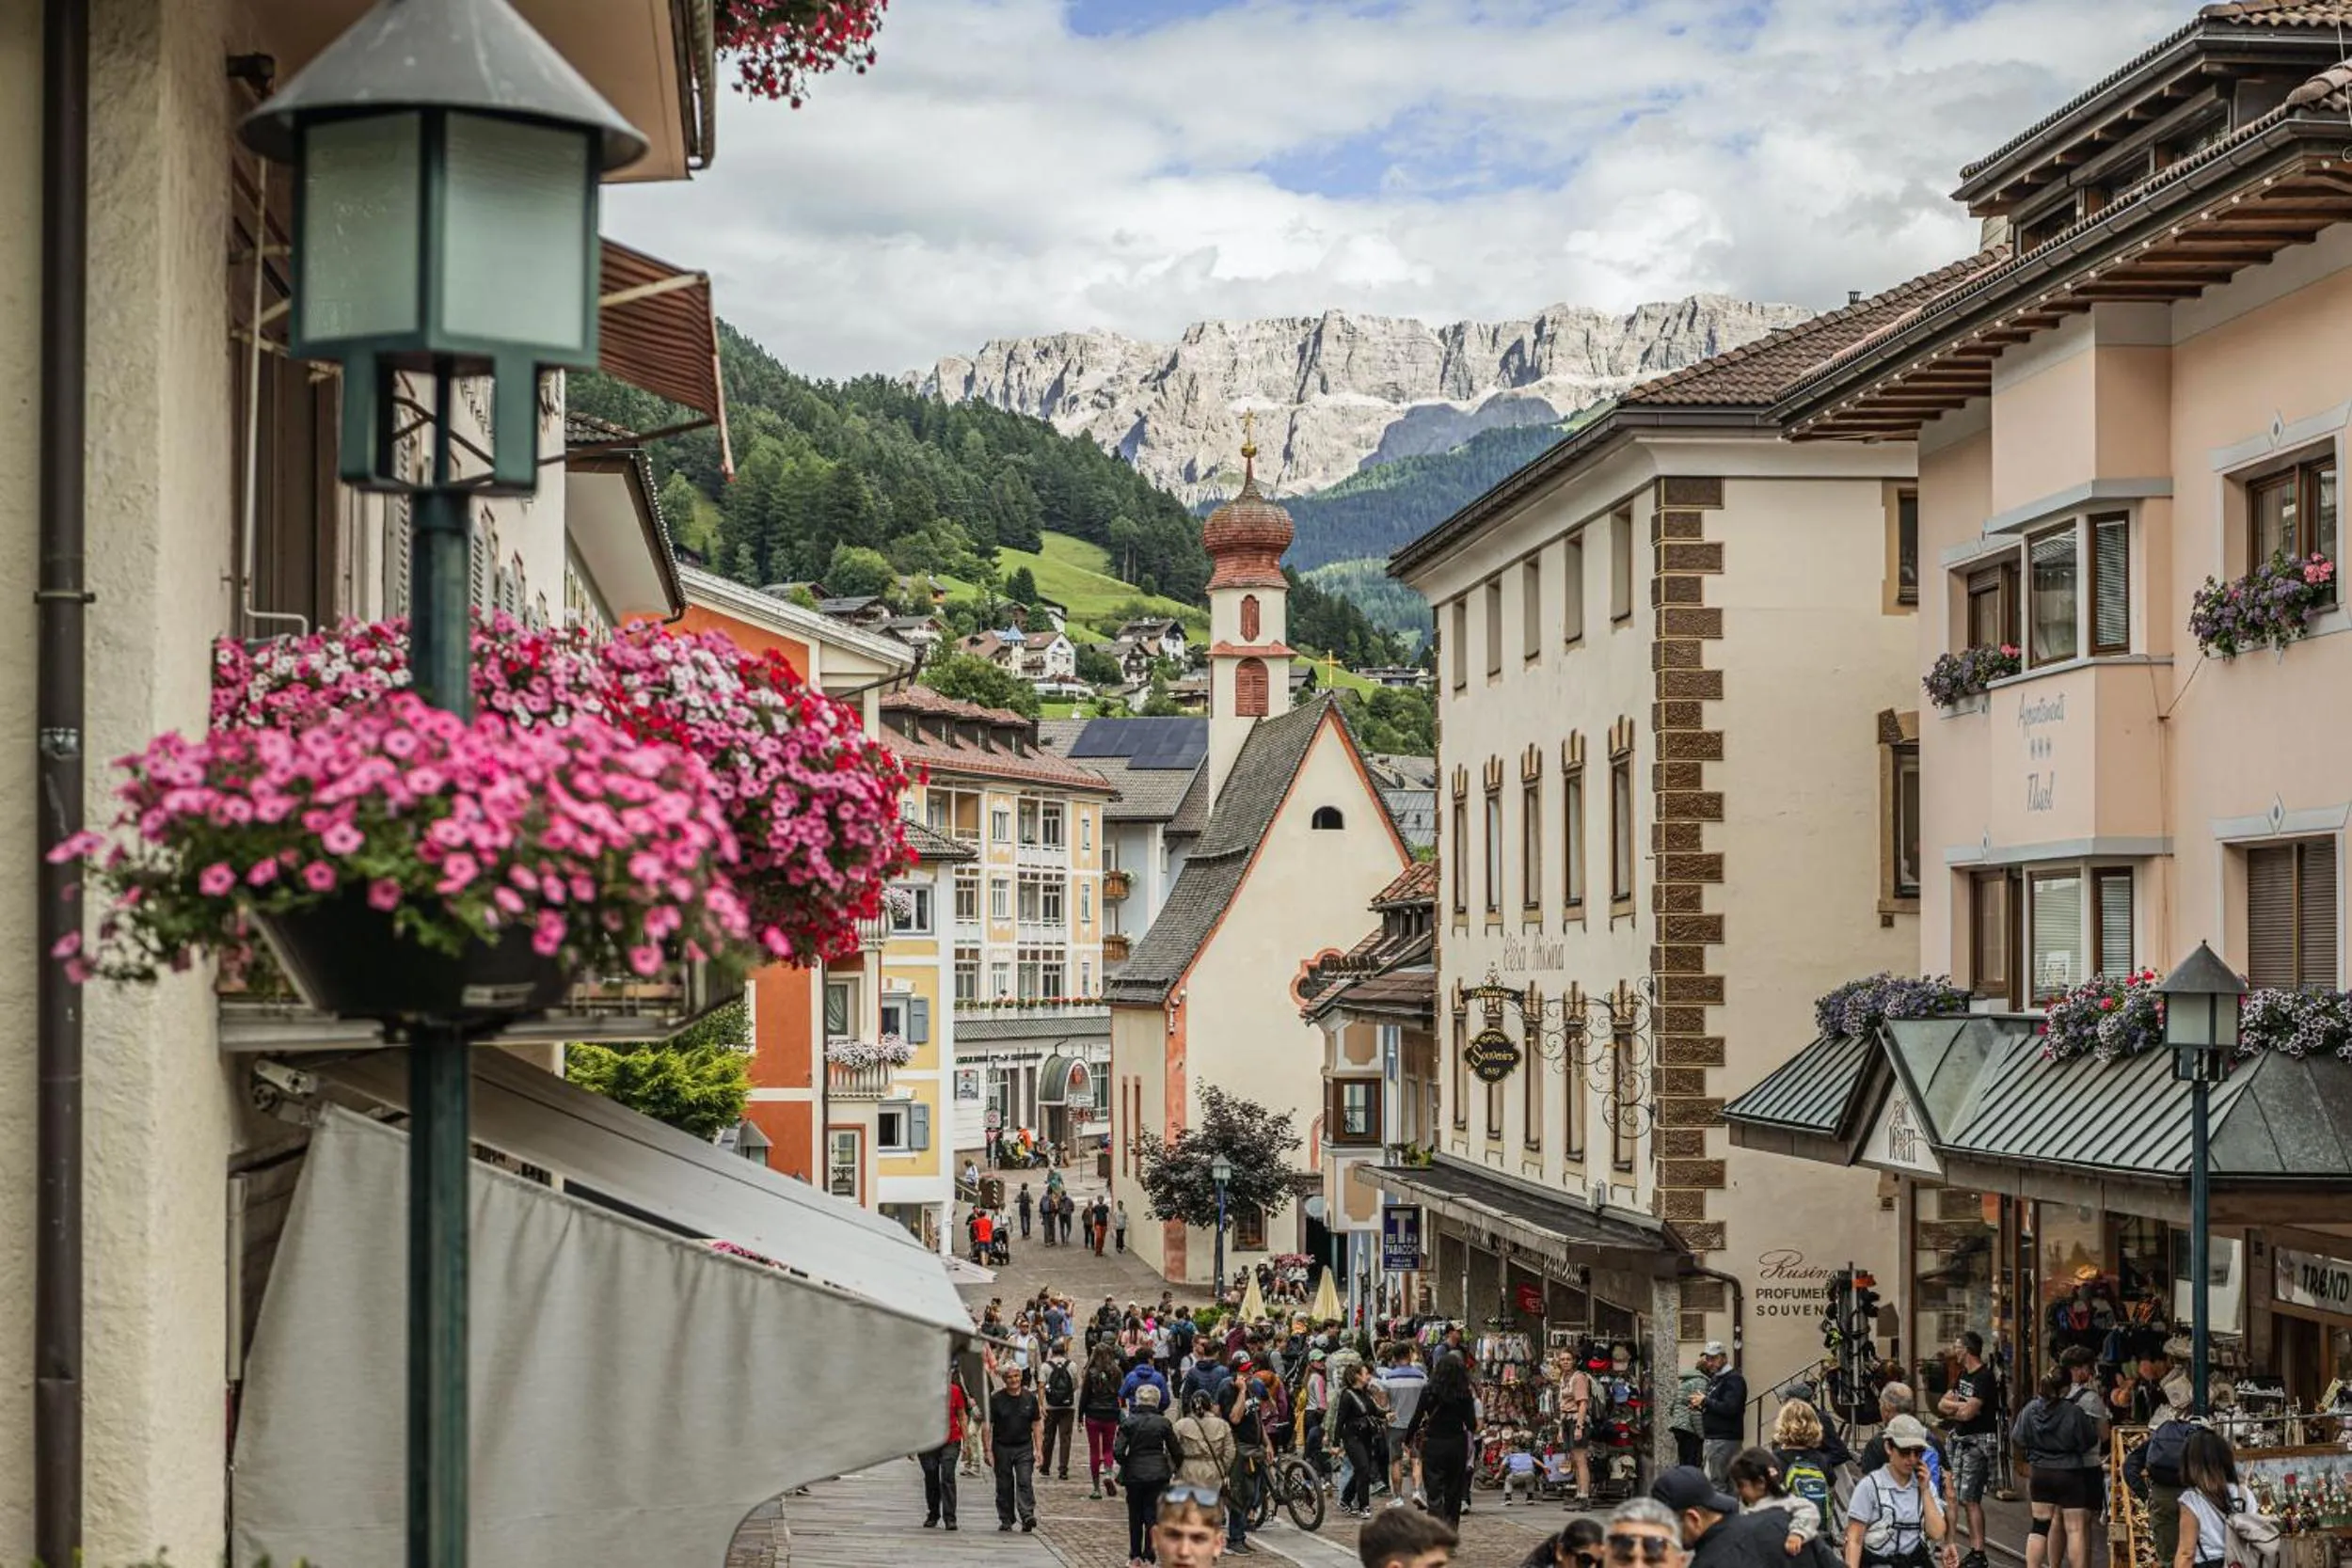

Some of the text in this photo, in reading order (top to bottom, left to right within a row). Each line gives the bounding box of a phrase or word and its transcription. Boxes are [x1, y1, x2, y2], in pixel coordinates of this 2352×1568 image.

[1470, 1044, 1514, 1067] Souvenirs
[1391, 1211, 1413, 1243] T
[1756, 1288, 1828, 1299] PROFUMER
[1756, 1305, 1824, 1316] SOUVEN
